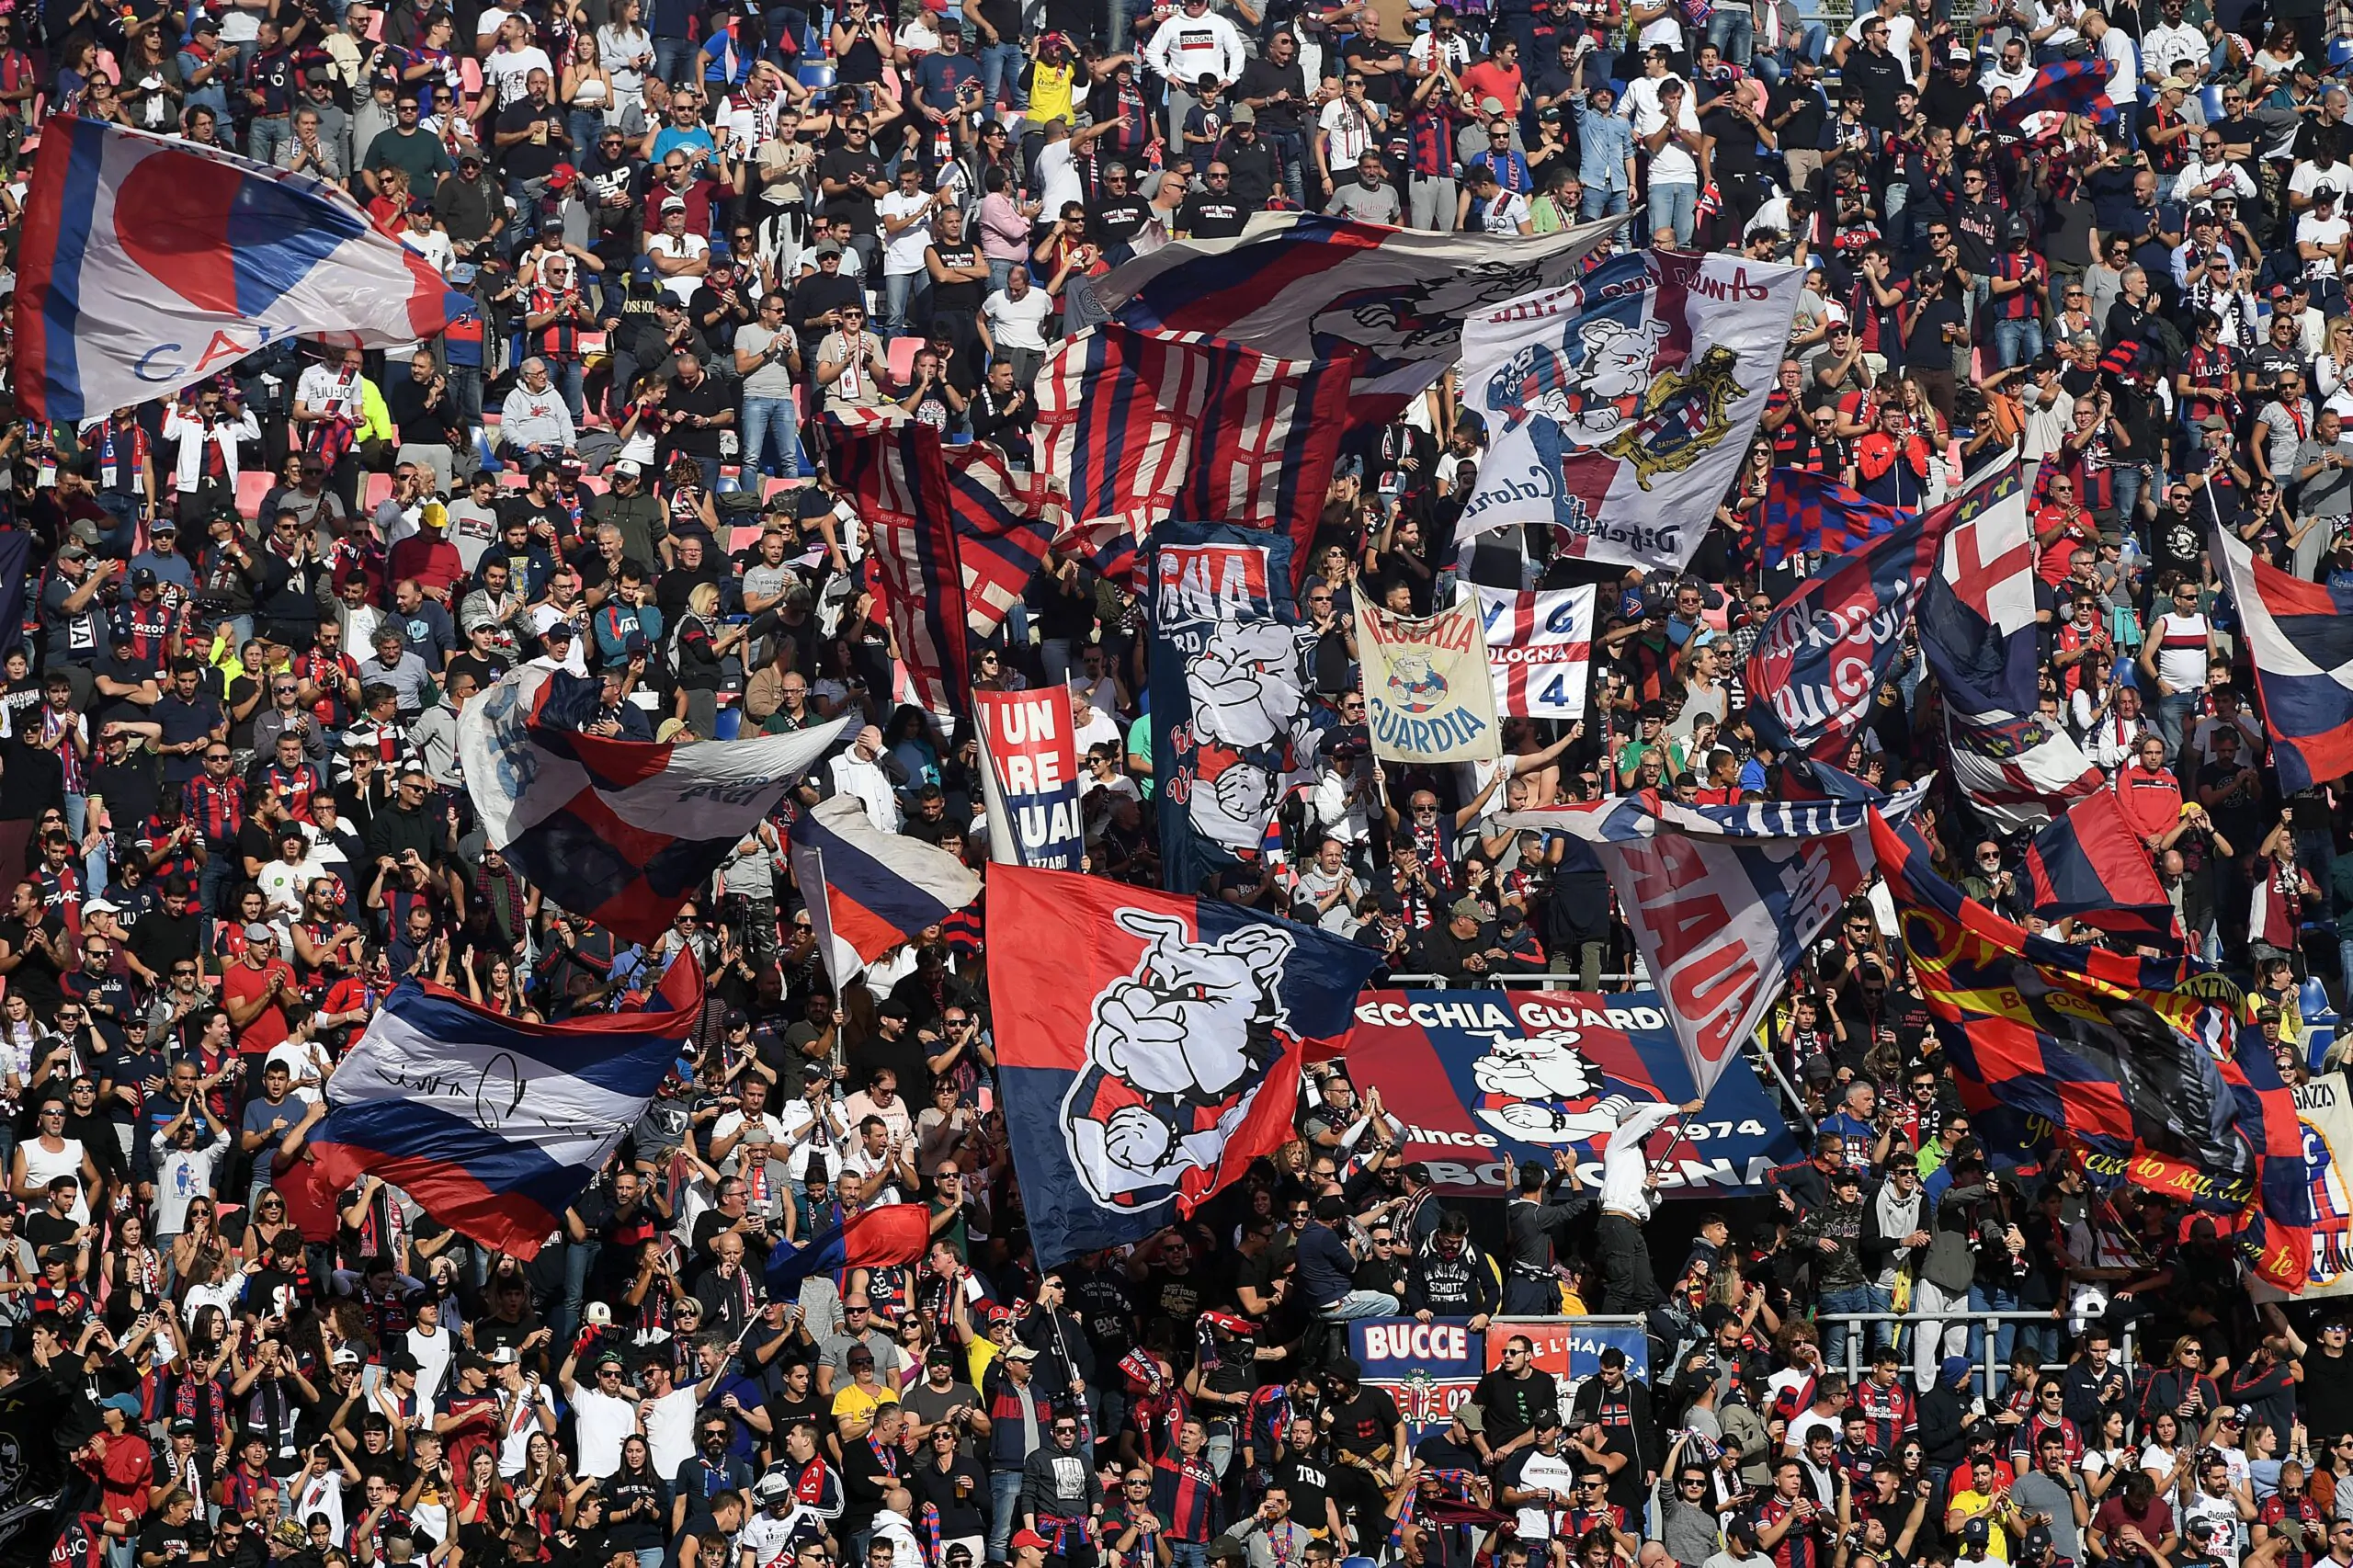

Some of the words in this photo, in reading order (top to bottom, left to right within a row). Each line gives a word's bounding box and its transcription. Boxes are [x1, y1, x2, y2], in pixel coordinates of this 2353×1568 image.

[1180, 35, 1214, 44] BOLOGNA
[593, 166, 631, 189] SUP
[1960, 217, 1983, 236] BOLOGNA
[2195, 363, 2231, 377] LIU·JO
[2264, 361, 2300, 372] FAAC
[316, 386, 352, 400] LIU·JO
[620, 617, 640, 633] VAN
[1545, 600, 1573, 633] G
[131, 625, 166, 636] CAZOO
[1362, 608, 1475, 653] VECCHIA
[1487, 646, 1568, 664] OLOGNA
[5, 688, 40, 705] BOLOGNA
[1539, 673, 1569, 707] 4
[1001, 699, 1055, 744] UN
[1370, 698, 1486, 754] GUARDIA
[995, 750, 1063, 797] RE
[44, 890, 82, 906] FAAC
[1356, 1002, 1515, 1029] ECCHIA
[1523, 1004, 1676, 1032] GUARD
[2268, 1245, 2294, 1277] te
[1428, 1282, 1463, 1293] SCHOTT
[1366, 1324, 1467, 1359] BUCCE
[1063, 1474, 1080, 1483] NYC
